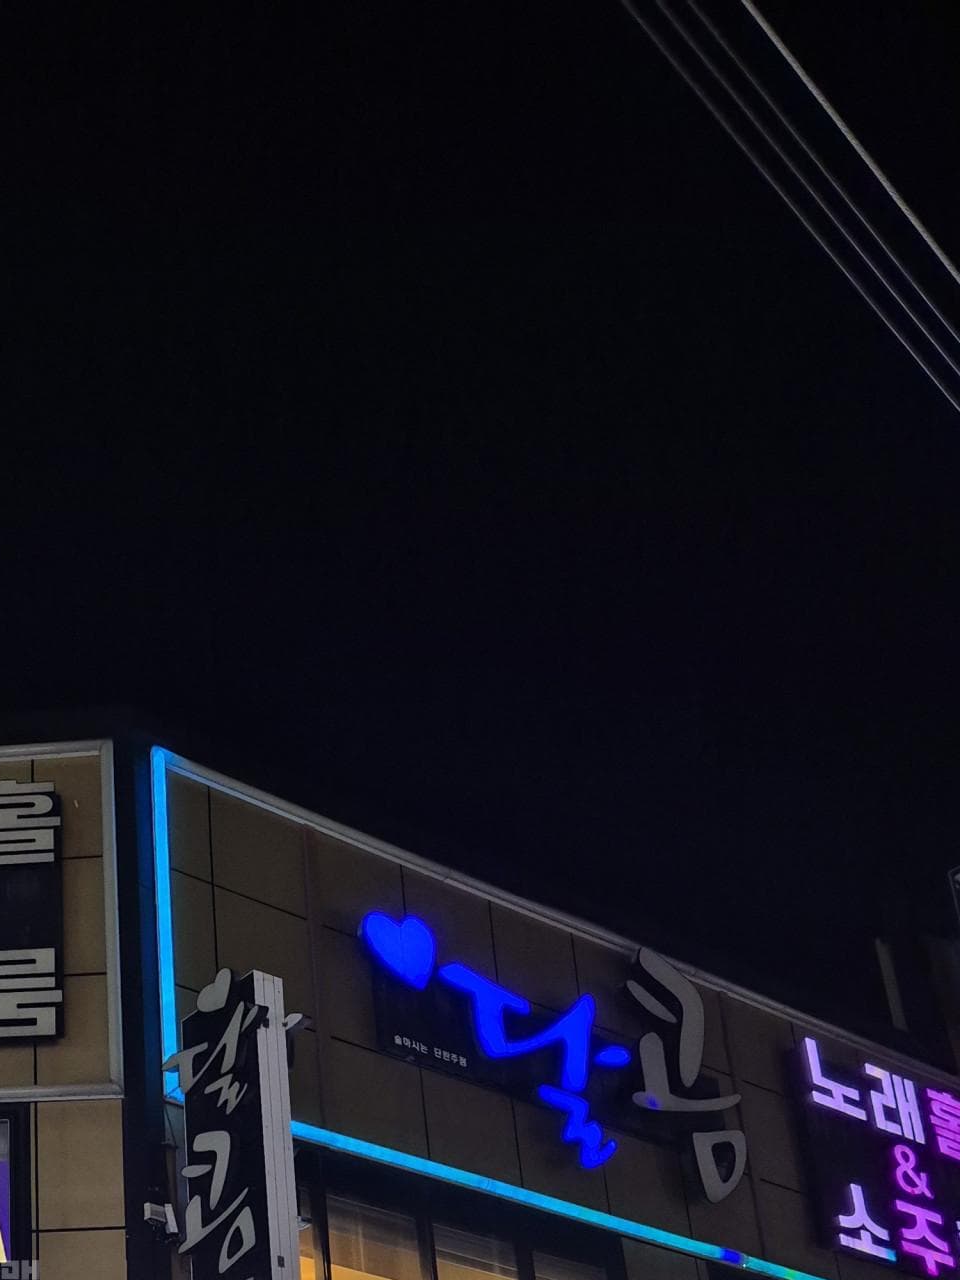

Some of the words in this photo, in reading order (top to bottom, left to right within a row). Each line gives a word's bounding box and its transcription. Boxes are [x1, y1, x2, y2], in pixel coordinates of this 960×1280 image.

[162, 1001, 258, 1274] 달콤
[440, 946, 746, 1202] 달콤
[838, 1183, 960, 1277] 소주
[893, 1144, 935, 1199] &
